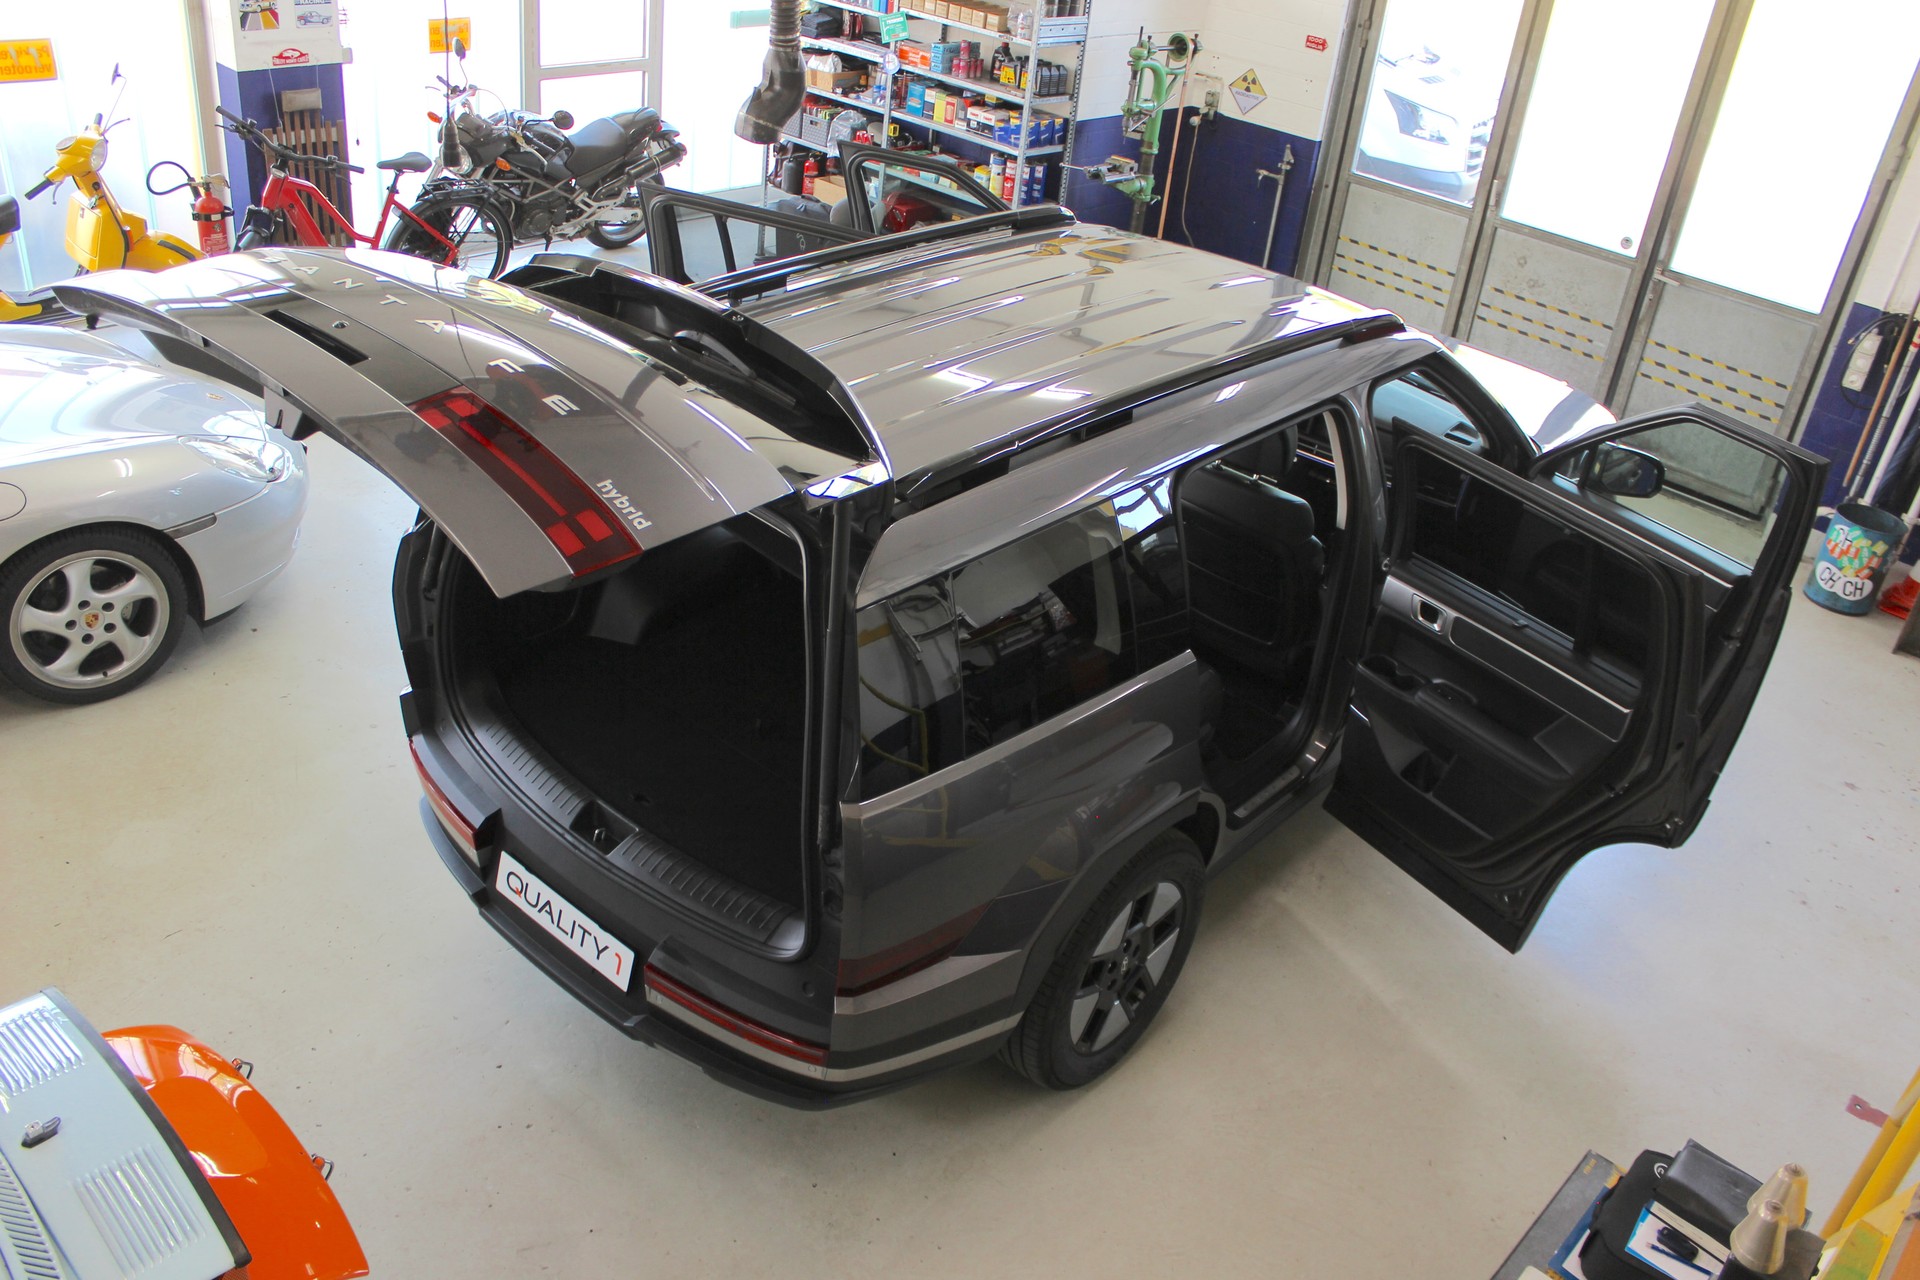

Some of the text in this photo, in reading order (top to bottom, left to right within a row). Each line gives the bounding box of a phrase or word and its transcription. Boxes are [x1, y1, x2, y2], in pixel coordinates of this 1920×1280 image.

[1308, 36, 1323, 44] 1000
[258, 255, 581, 417] SANTA FE
[596, 478, 653, 531] hybrid
[1820, 566, 1842, 589] CH
[1843, 580, 1865, 598] CH
[506, 871, 623, 976] QUALITY 1
